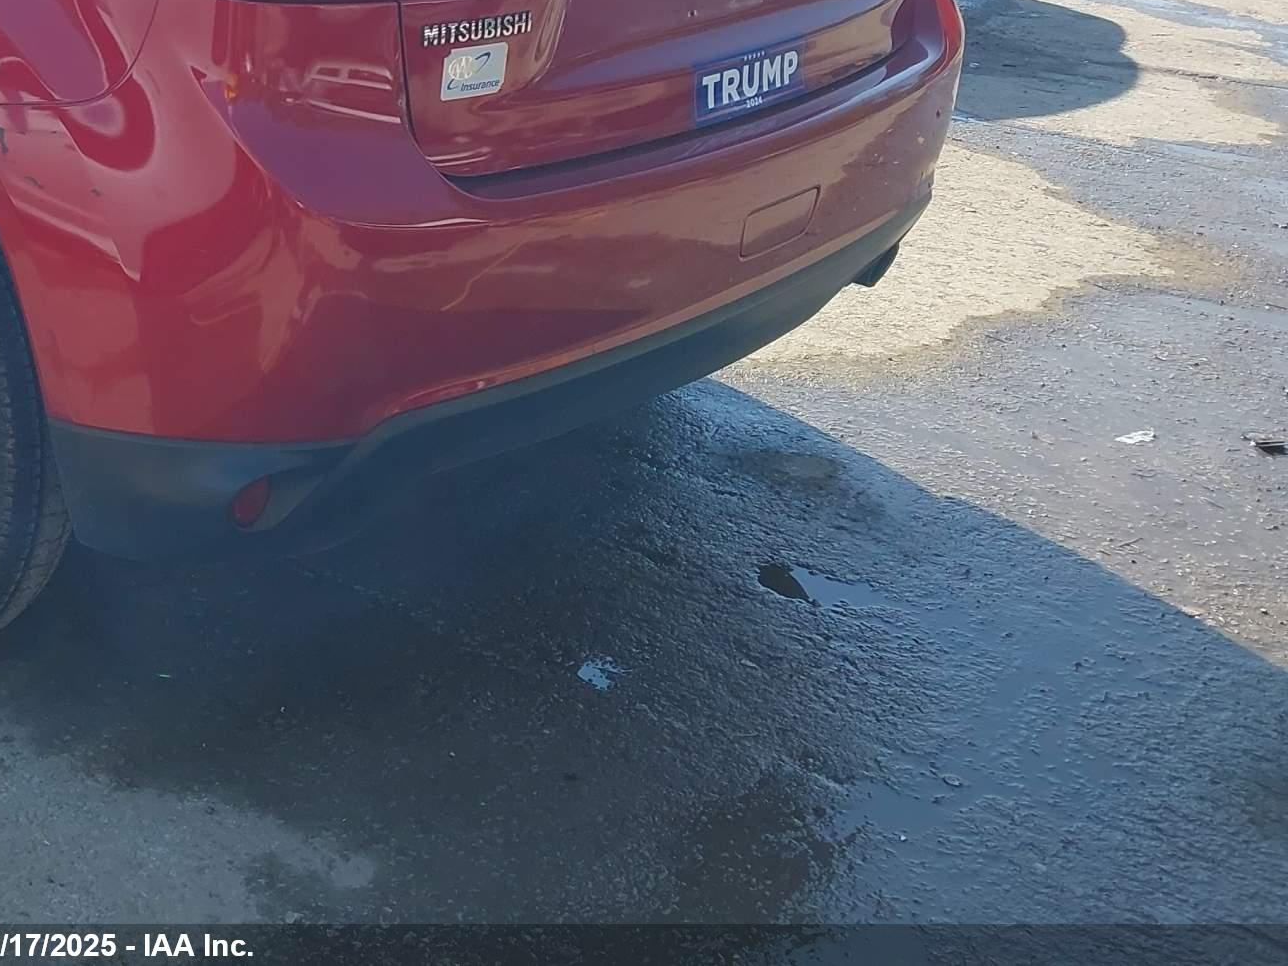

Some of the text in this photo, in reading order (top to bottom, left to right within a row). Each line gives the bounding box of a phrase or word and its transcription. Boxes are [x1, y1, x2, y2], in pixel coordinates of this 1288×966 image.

[422, 11, 532, 47] MITSUBISHI
[460, 79, 500, 91] Insurance
[702, 50, 799, 109] TRUMP
